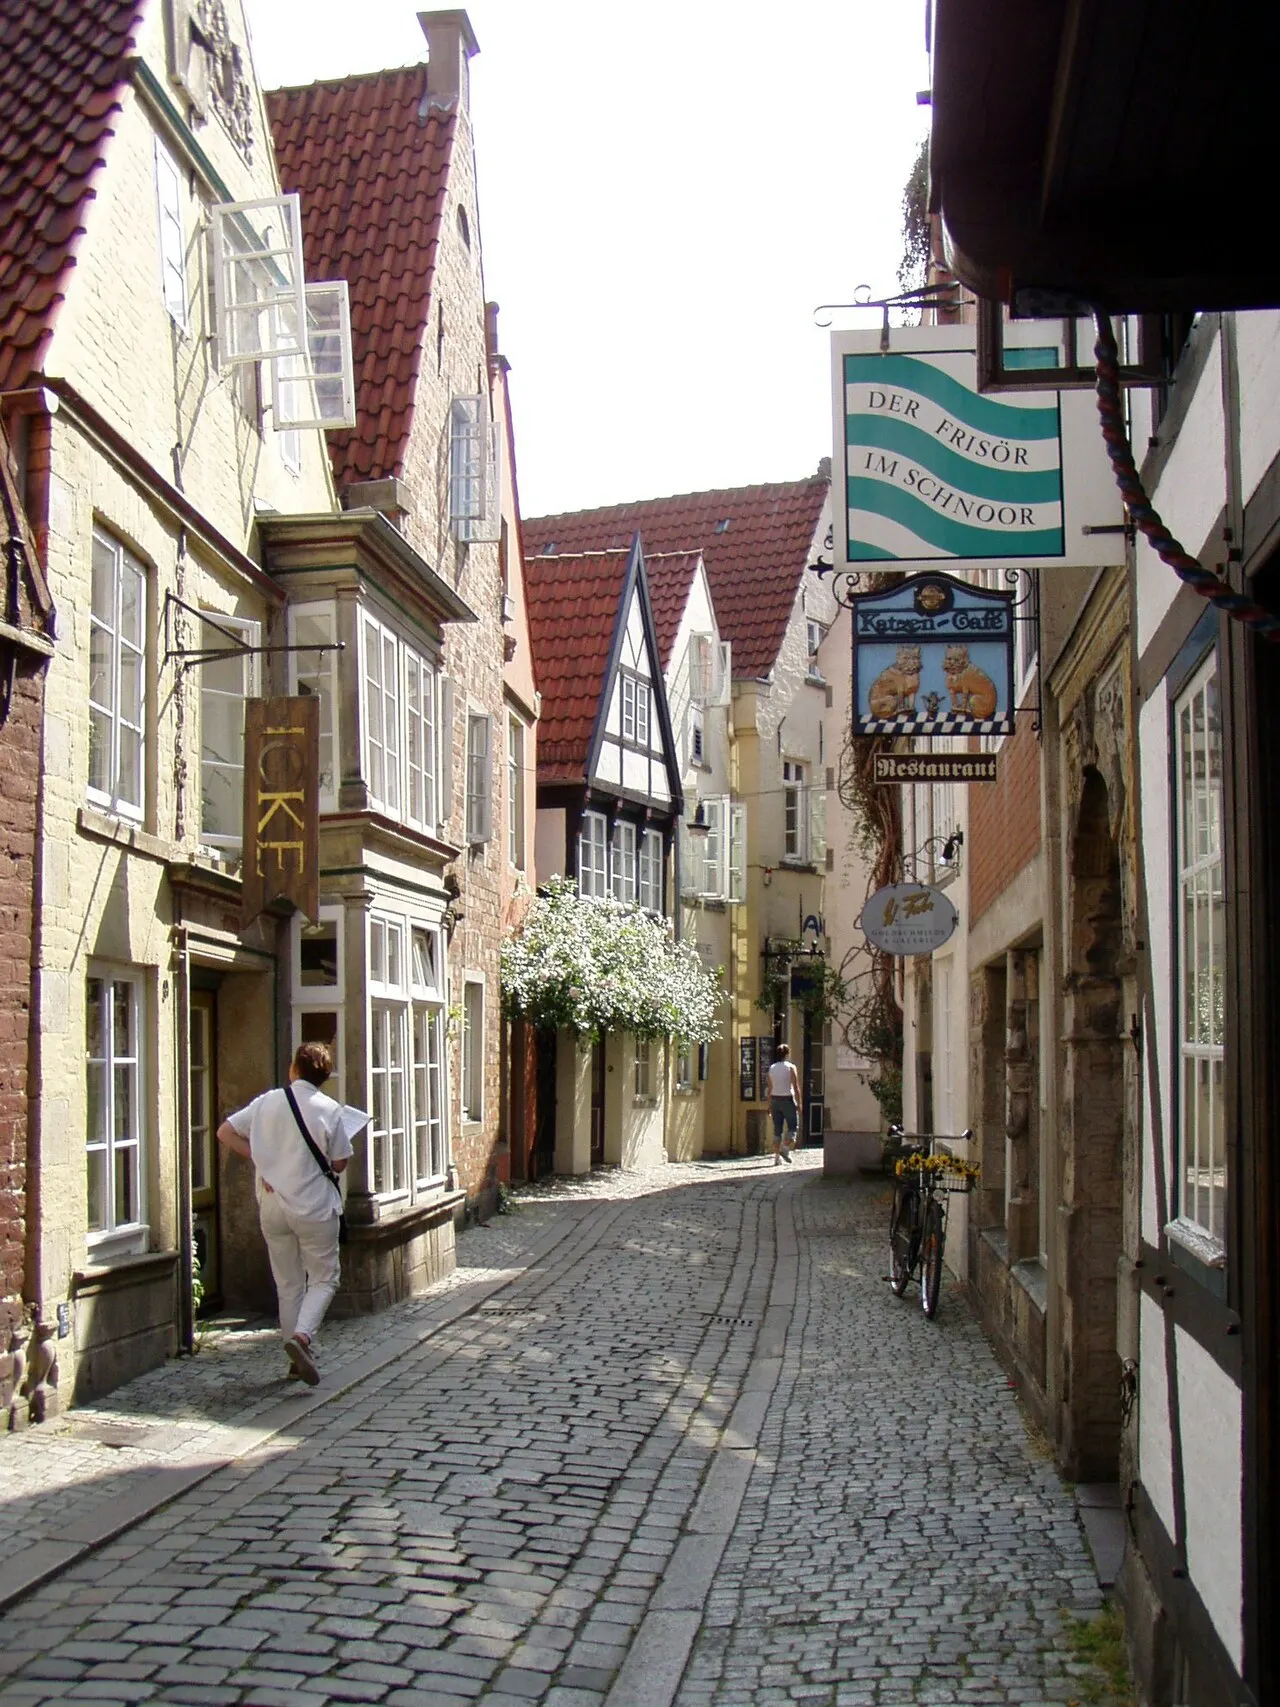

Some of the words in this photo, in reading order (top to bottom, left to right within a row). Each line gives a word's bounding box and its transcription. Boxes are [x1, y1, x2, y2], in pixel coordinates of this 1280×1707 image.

[868, 390, 921, 420] DER
[933, 418, 1029, 466] FRISÖR
[863, 452, 898, 478] IM
[903, 468, 1036, 526] SCHNOOR
[876, 758, 997, 778] Restaurant
